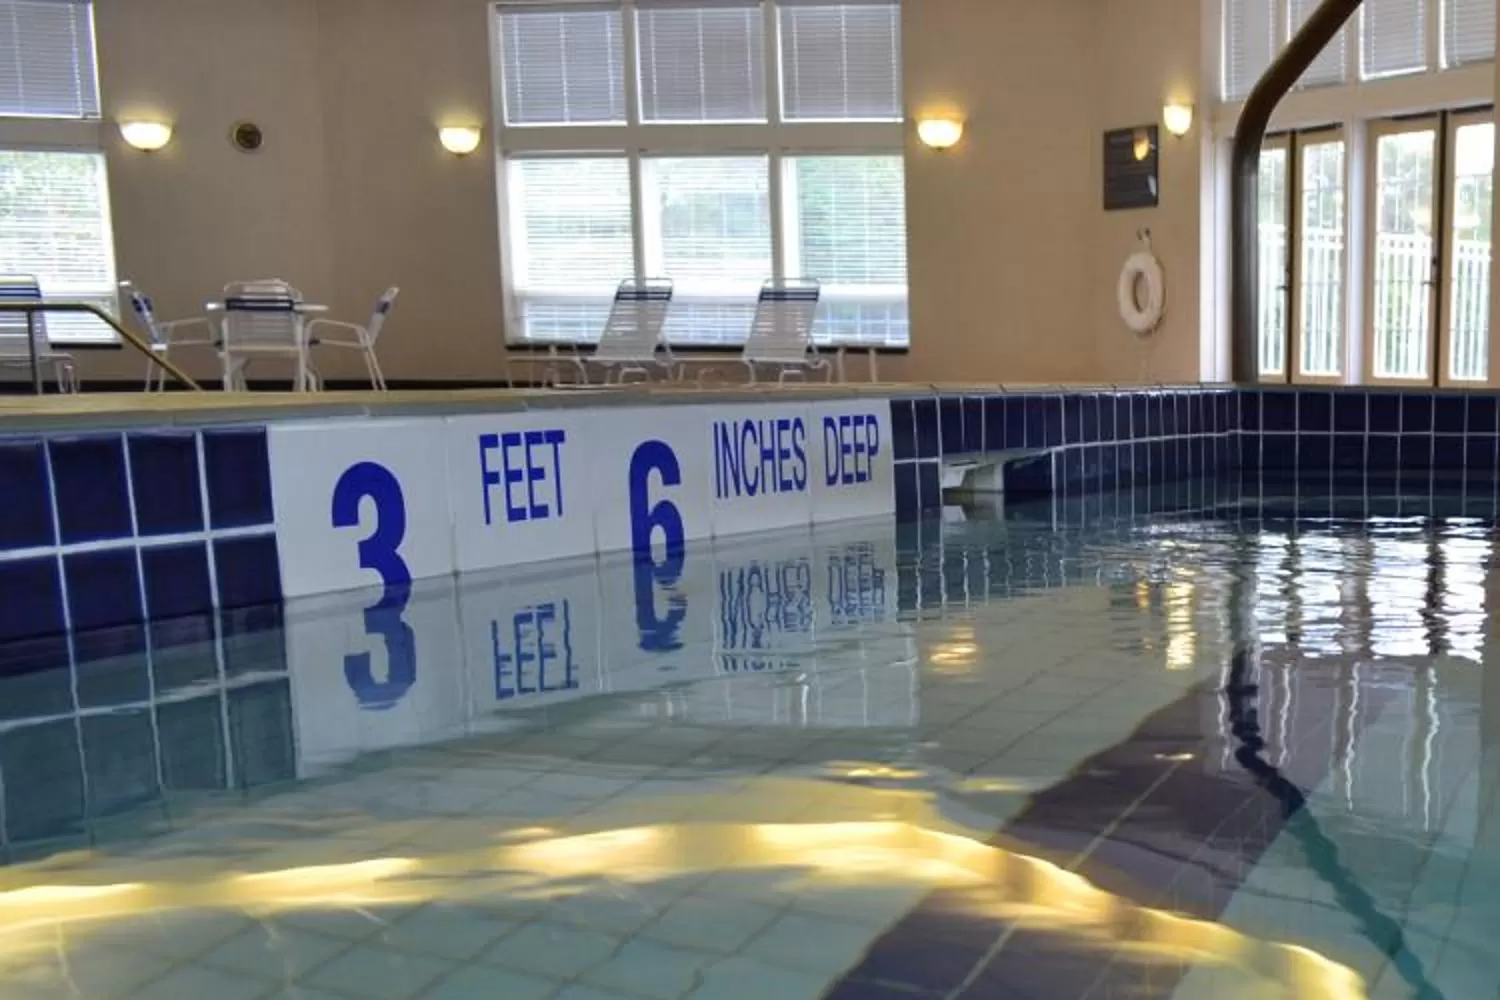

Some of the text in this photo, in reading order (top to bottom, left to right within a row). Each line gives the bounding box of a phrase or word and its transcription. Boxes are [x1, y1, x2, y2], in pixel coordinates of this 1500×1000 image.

[332, 414, 879, 600] 3 FEET 6 INCHES DEEP
